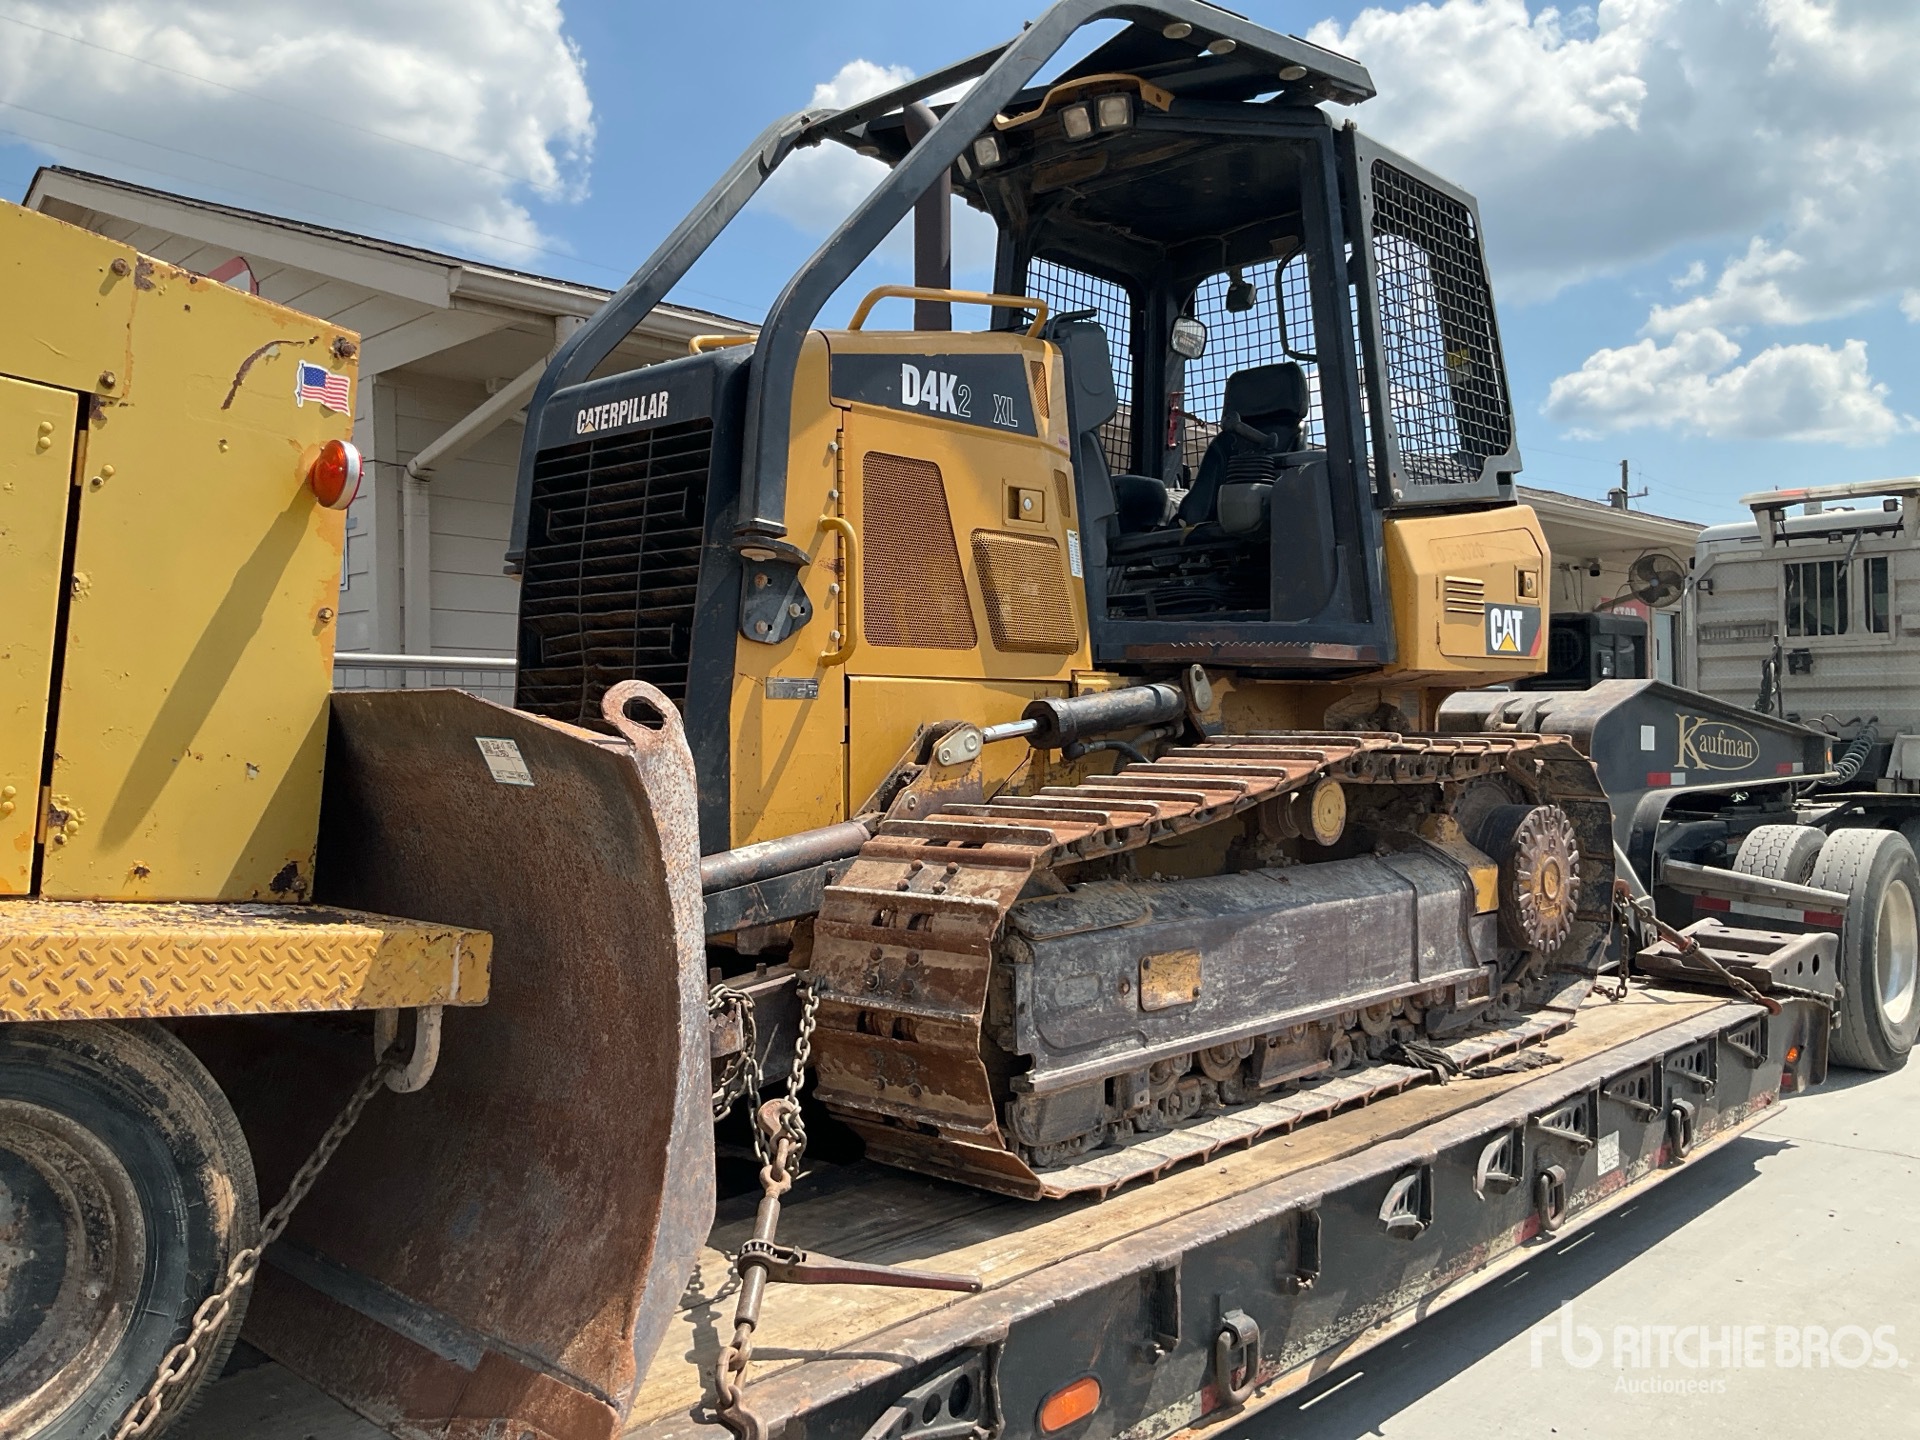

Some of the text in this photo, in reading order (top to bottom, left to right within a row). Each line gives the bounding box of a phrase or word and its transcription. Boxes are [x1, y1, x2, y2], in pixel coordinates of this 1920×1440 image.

[576, 390, 669, 435] CATERPILLAR
[902, 363, 1018, 427] D4K2 XL
[1490, 607, 1523, 652] CAT
[1674, 713, 1753, 770] Kaufman
